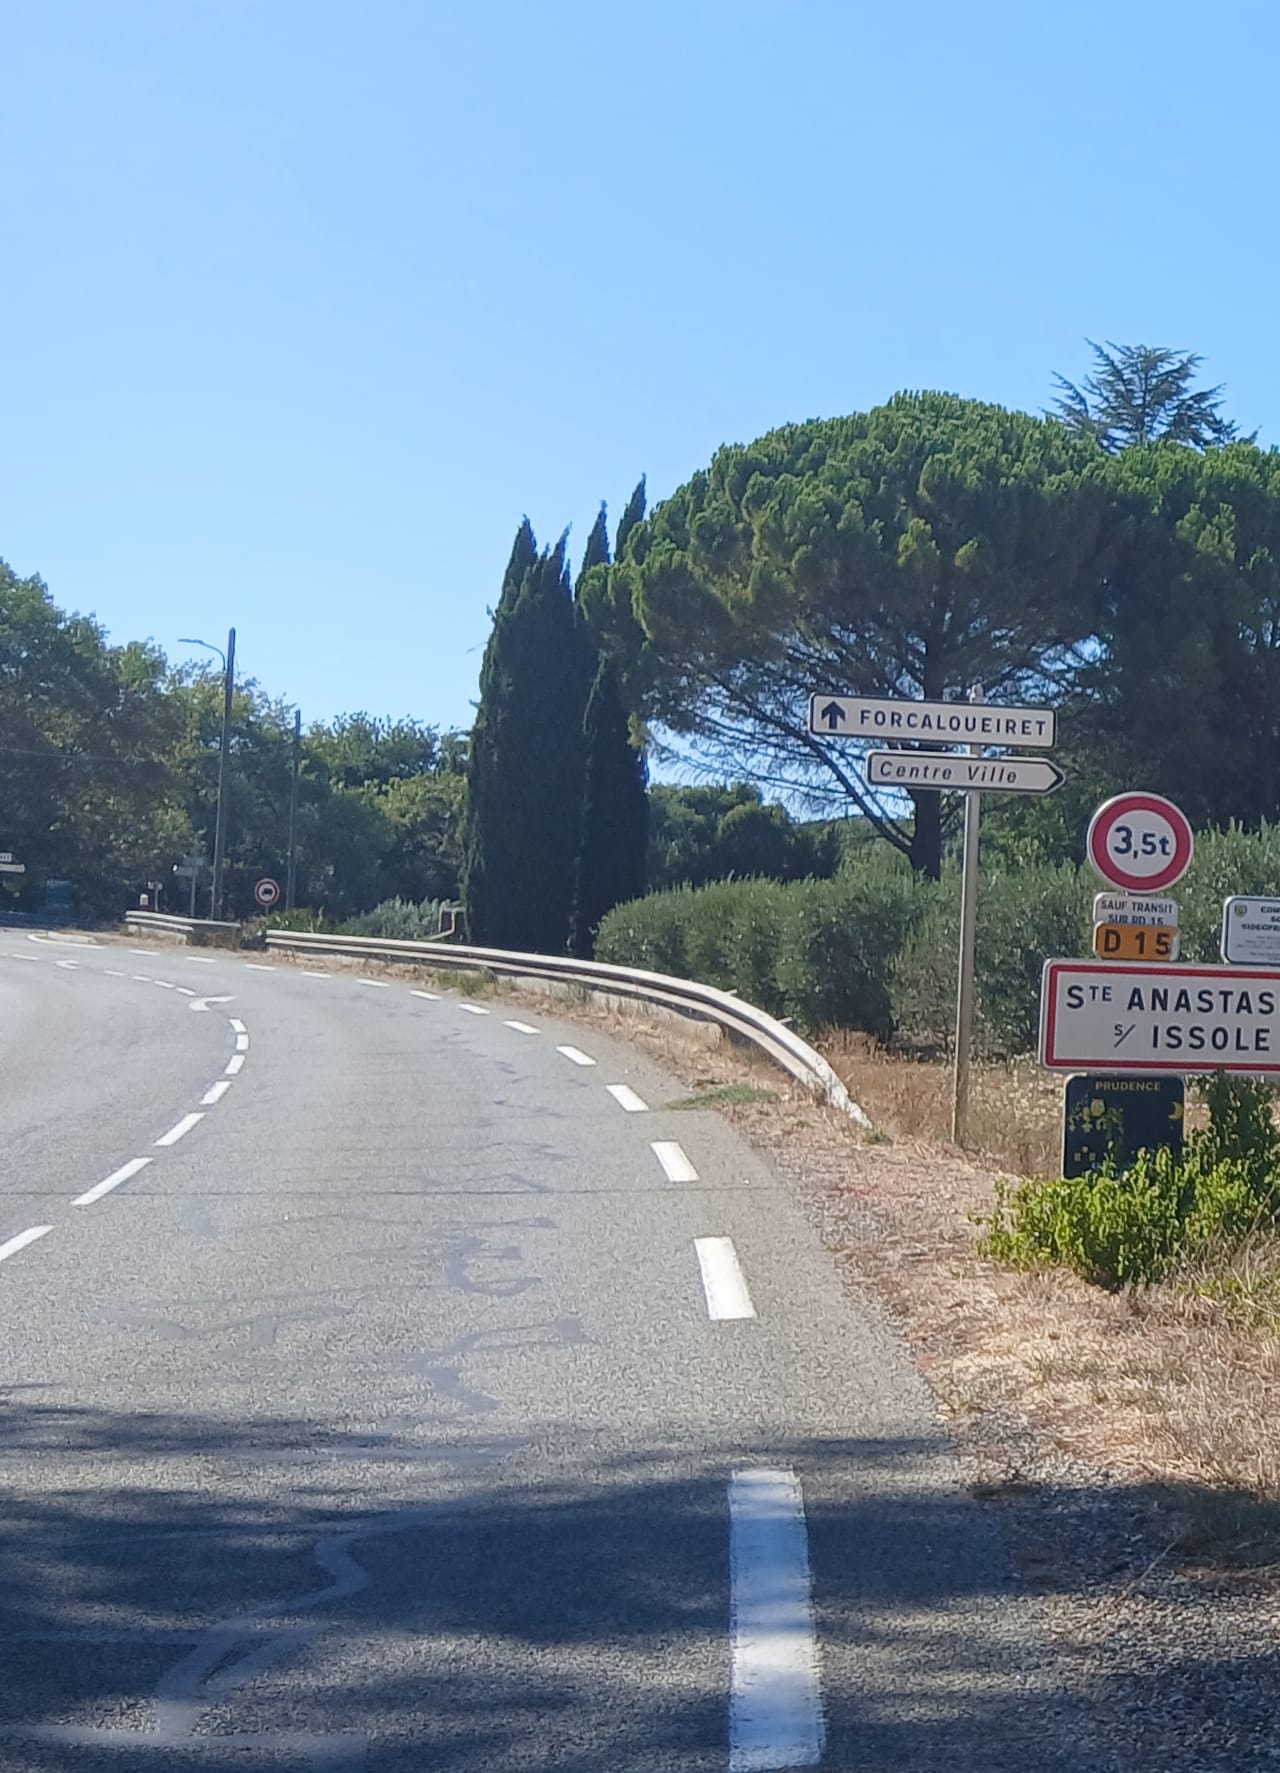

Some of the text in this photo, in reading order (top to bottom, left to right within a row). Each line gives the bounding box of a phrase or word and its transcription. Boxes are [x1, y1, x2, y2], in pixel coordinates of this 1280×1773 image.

[880, 761, 1017, 784] Centre Ville
[1113, 825, 1170, 859] 3,5t
[1101, 899, 1174, 914] SAUF TRANSIT
[1104, 929, 1170, 956] D 15
[1152, 1025, 1270, 1051] ISSOLE
[1095, 1081, 1161, 1091] PRUDENCE
